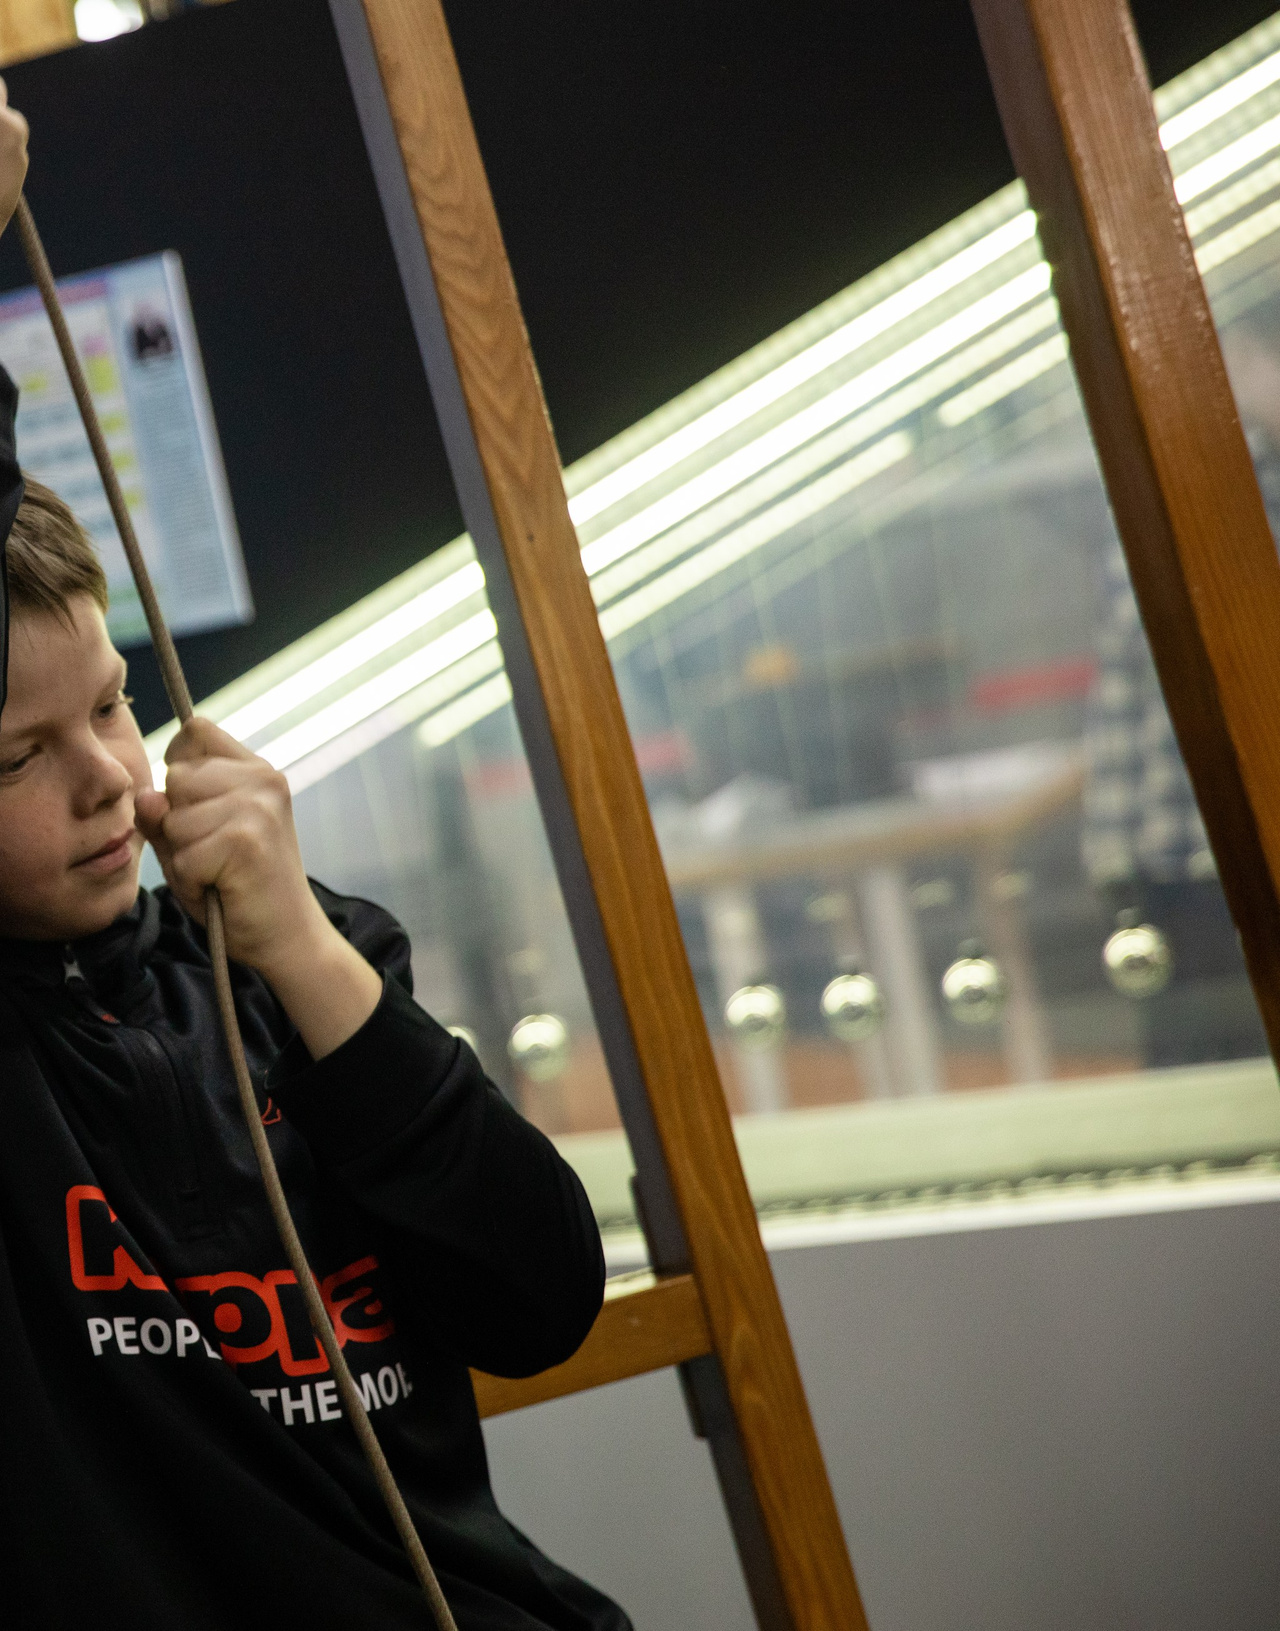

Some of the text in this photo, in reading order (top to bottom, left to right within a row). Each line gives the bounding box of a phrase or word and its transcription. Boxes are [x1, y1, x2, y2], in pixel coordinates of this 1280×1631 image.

[65, 1184, 396, 1377] Kppa
[87, 1316, 223, 1360] PEOPL
[250, 1380, 343, 1426] THE
